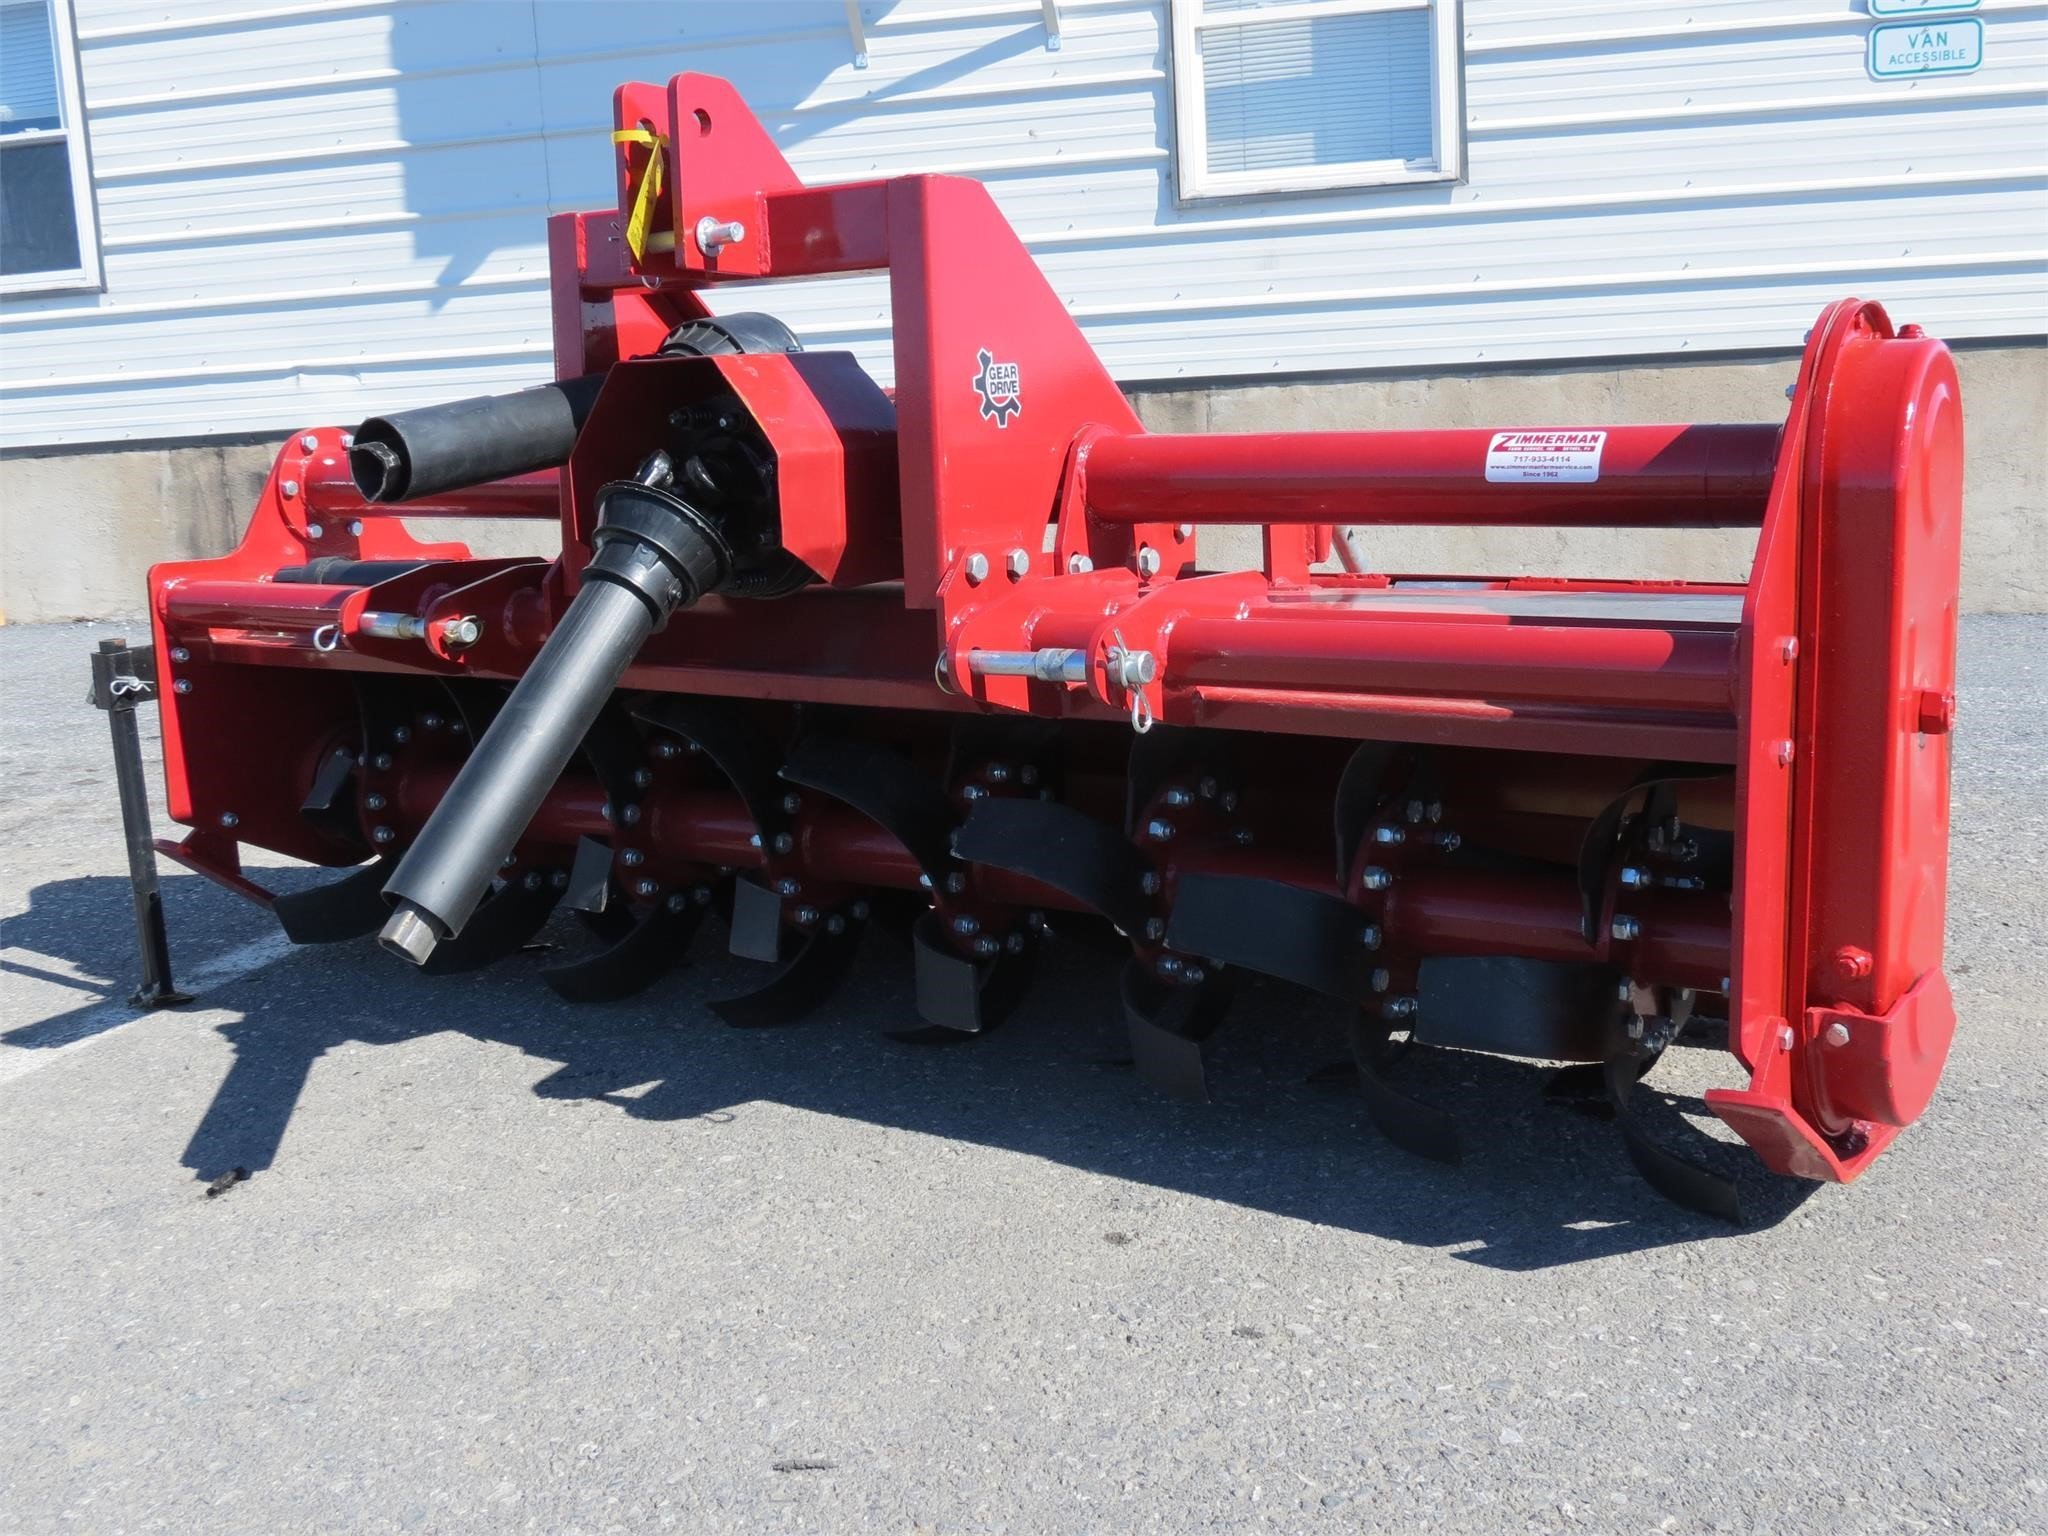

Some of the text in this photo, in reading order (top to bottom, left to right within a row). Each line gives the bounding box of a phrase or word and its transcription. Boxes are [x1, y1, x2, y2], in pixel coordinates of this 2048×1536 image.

[1908, 31, 1947, 49] VAN
[1889, 48, 1966, 64] ACCESSIBLE
[989, 366, 1016, 380] GEAR
[990, 380, 1017, 395] DRIVE
[1492, 434, 1600, 452] ZIMMERMAN
